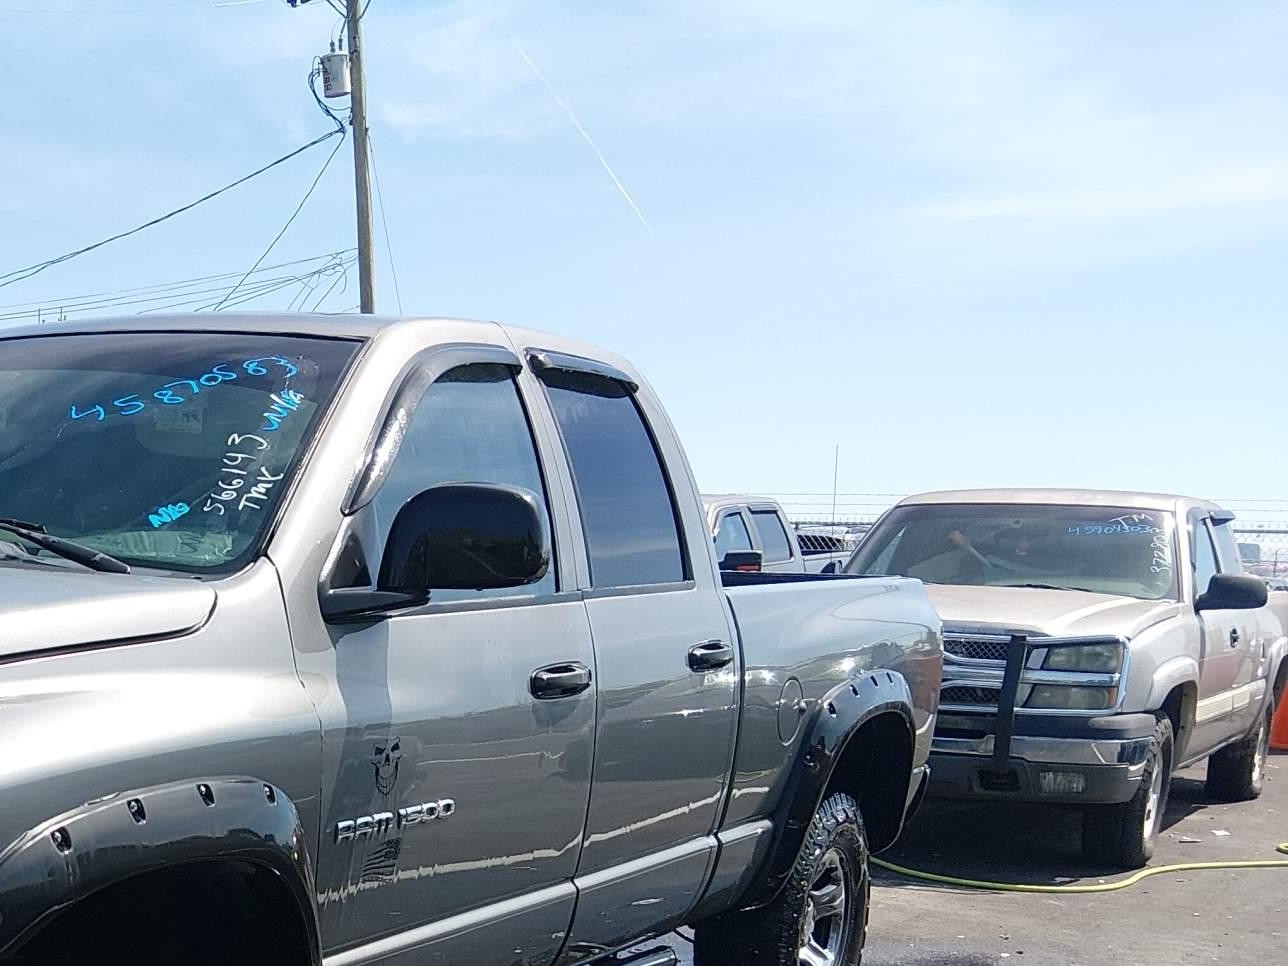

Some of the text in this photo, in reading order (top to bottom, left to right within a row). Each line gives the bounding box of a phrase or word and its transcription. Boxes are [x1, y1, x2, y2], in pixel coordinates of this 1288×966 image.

[71, 354, 298, 421] 45870583
[203, 433, 268, 515] 566143
[334, 799, 455, 845] RAM 1500
